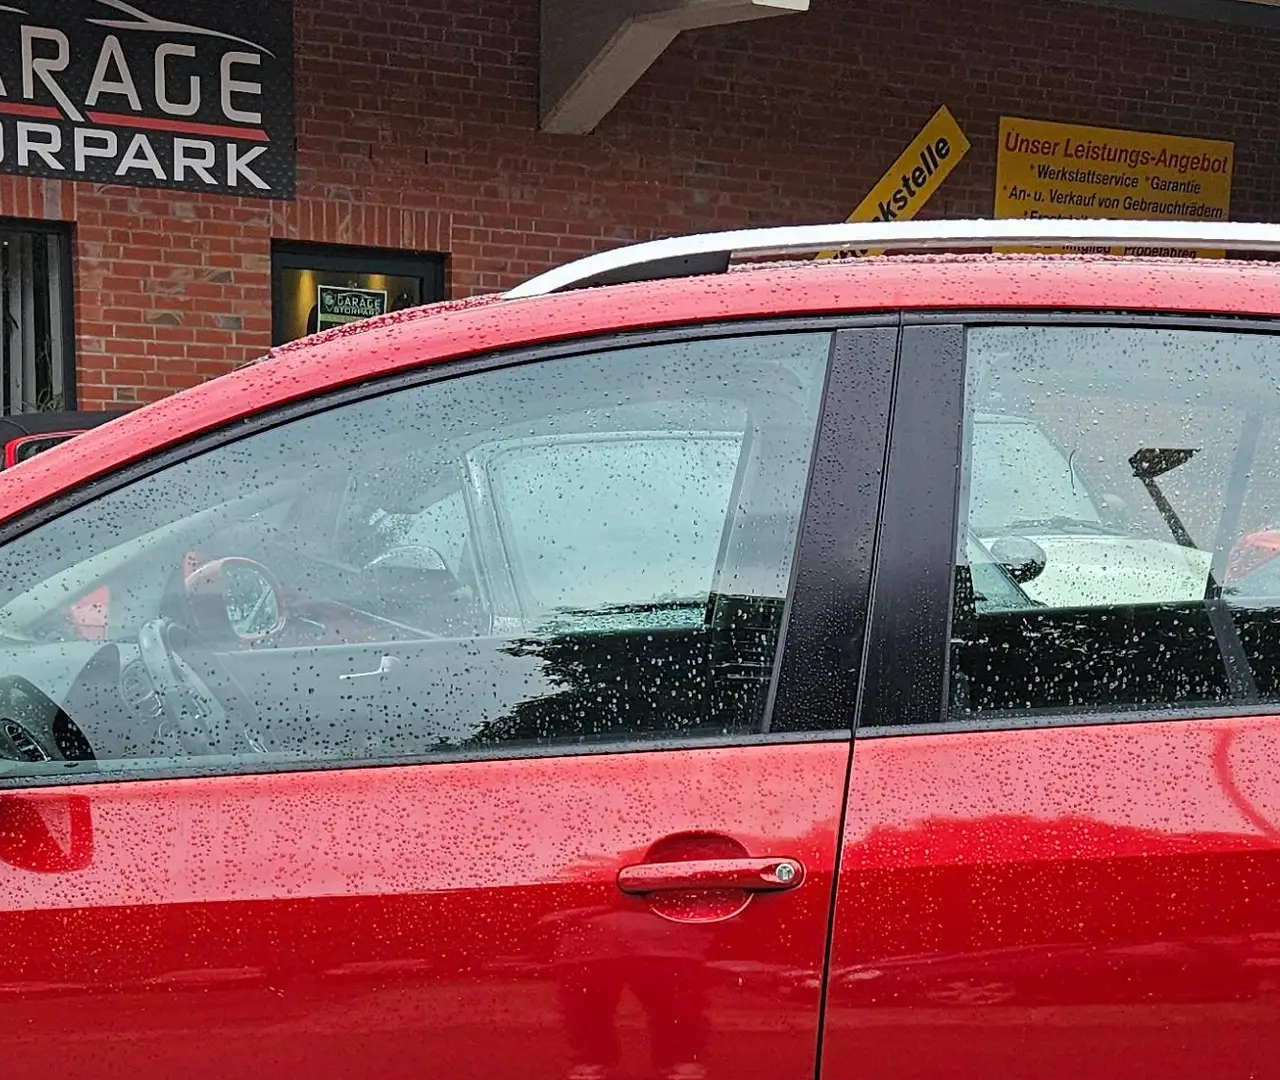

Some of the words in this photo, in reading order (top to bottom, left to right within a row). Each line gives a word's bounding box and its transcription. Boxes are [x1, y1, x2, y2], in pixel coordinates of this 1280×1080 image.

[1005, 131, 1060, 157] Unser
[1063, 138, 1229, 174] Leistungs-Angebot
[1049, 189, 1097, 207] Verkauf
[1098, 198, 1120, 209] von
[337, 293, 381, 309] GARAGE
